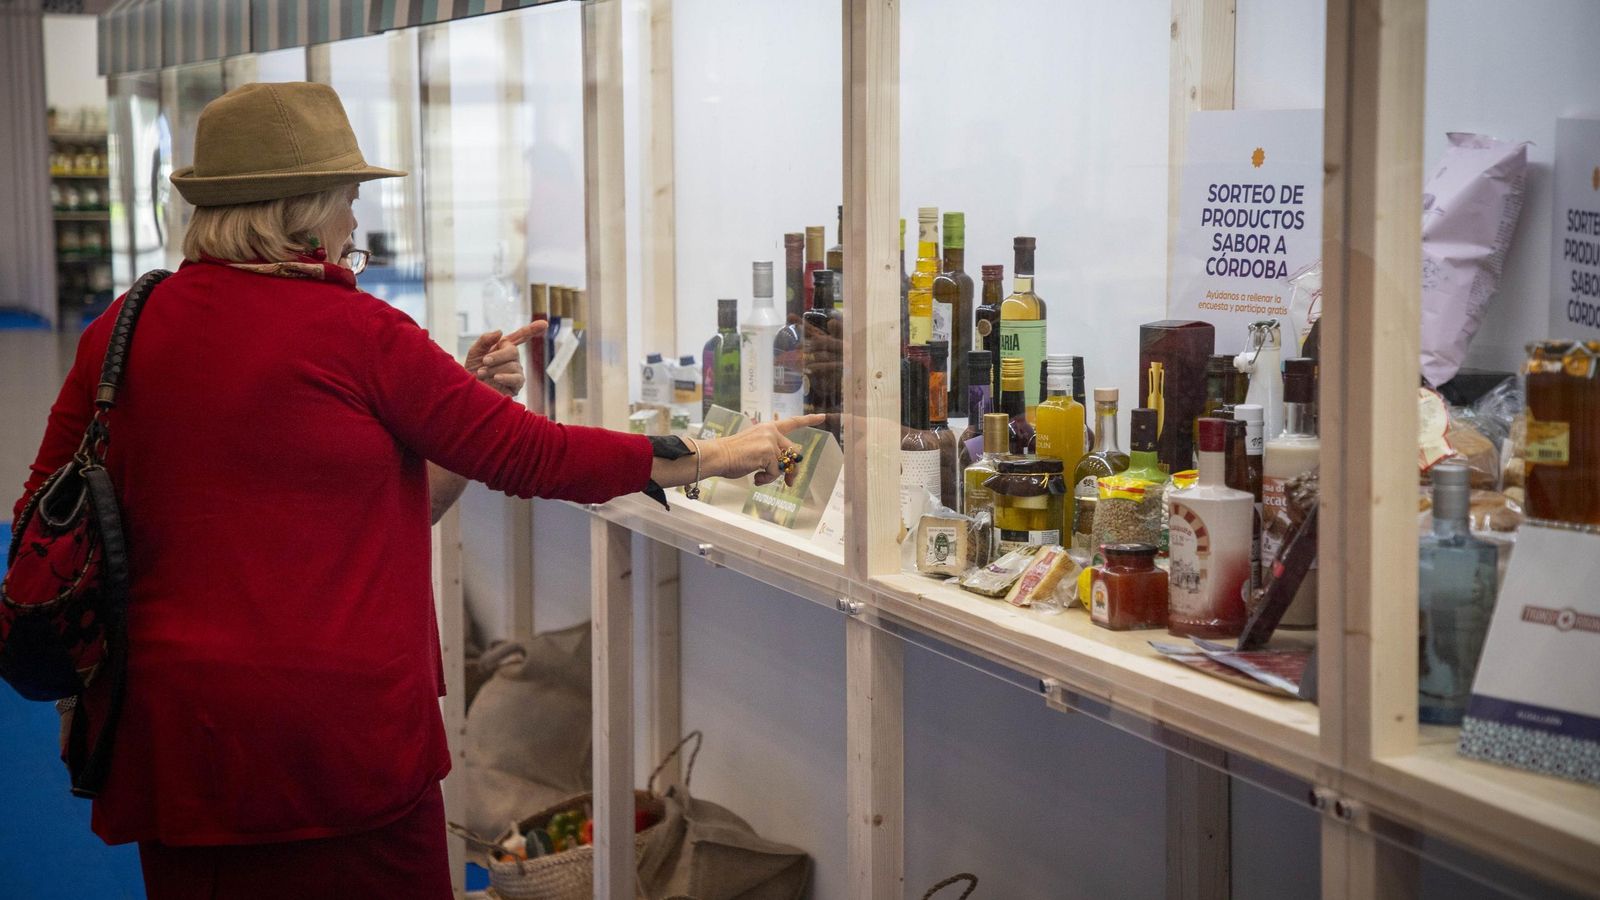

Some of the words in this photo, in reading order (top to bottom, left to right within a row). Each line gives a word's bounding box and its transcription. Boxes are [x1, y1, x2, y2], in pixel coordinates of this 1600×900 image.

[1207, 183, 1276, 205] SORTEO
[1280, 184, 1305, 205] DE
[1201, 208, 1305, 230] PRODUCTOS
[1567, 208, 1600, 236] SORTE
[1212, 232, 1271, 254] SABOR
[1273, 235, 1287, 255] A
[1205, 252, 1288, 279] CÓRDOBA
[1205, 289, 1240, 301] Ayúdanos
[1247, 292, 1273, 303] rellenar
[1274, 294, 1282, 304] la
[1198, 301, 1229, 311] encuesta
[1229, 303, 1234, 312] y
[1234, 303, 1266, 315] participa
[1267, 305, 1288, 316] gratis
